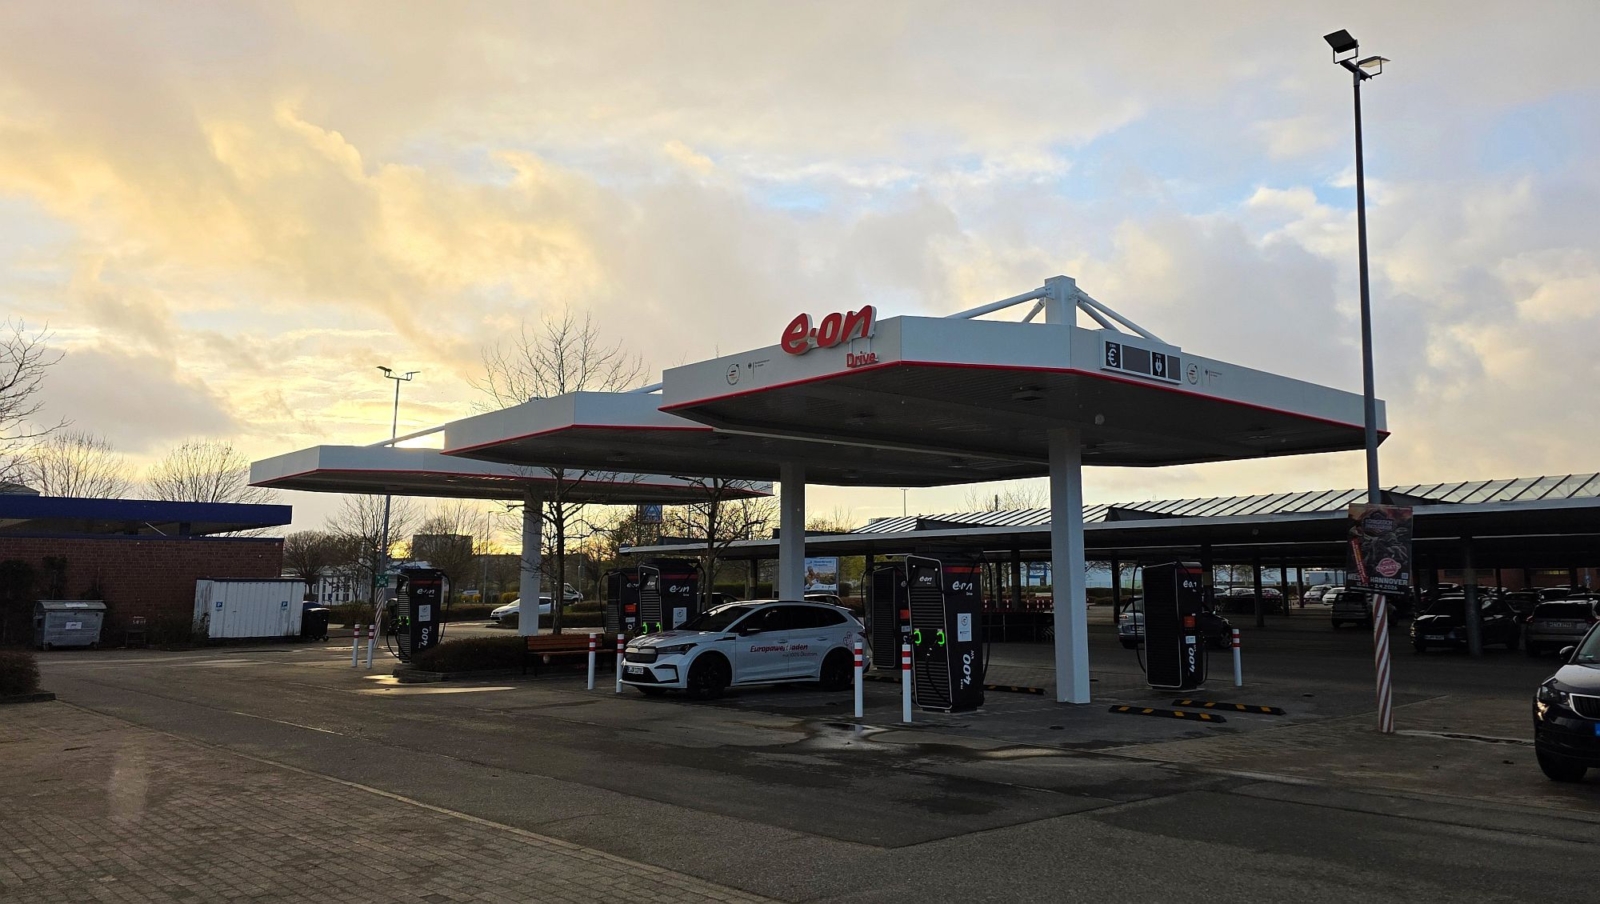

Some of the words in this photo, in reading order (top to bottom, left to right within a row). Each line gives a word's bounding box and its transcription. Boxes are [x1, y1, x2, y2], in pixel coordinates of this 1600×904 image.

[846, 351, 878, 368] Drive
[1370, 576, 1408, 586] HANNOVER
[421, 627, 429, 646] 400
[963, 653, 972, 685] 400
[1188, 646, 1196, 673] 400
